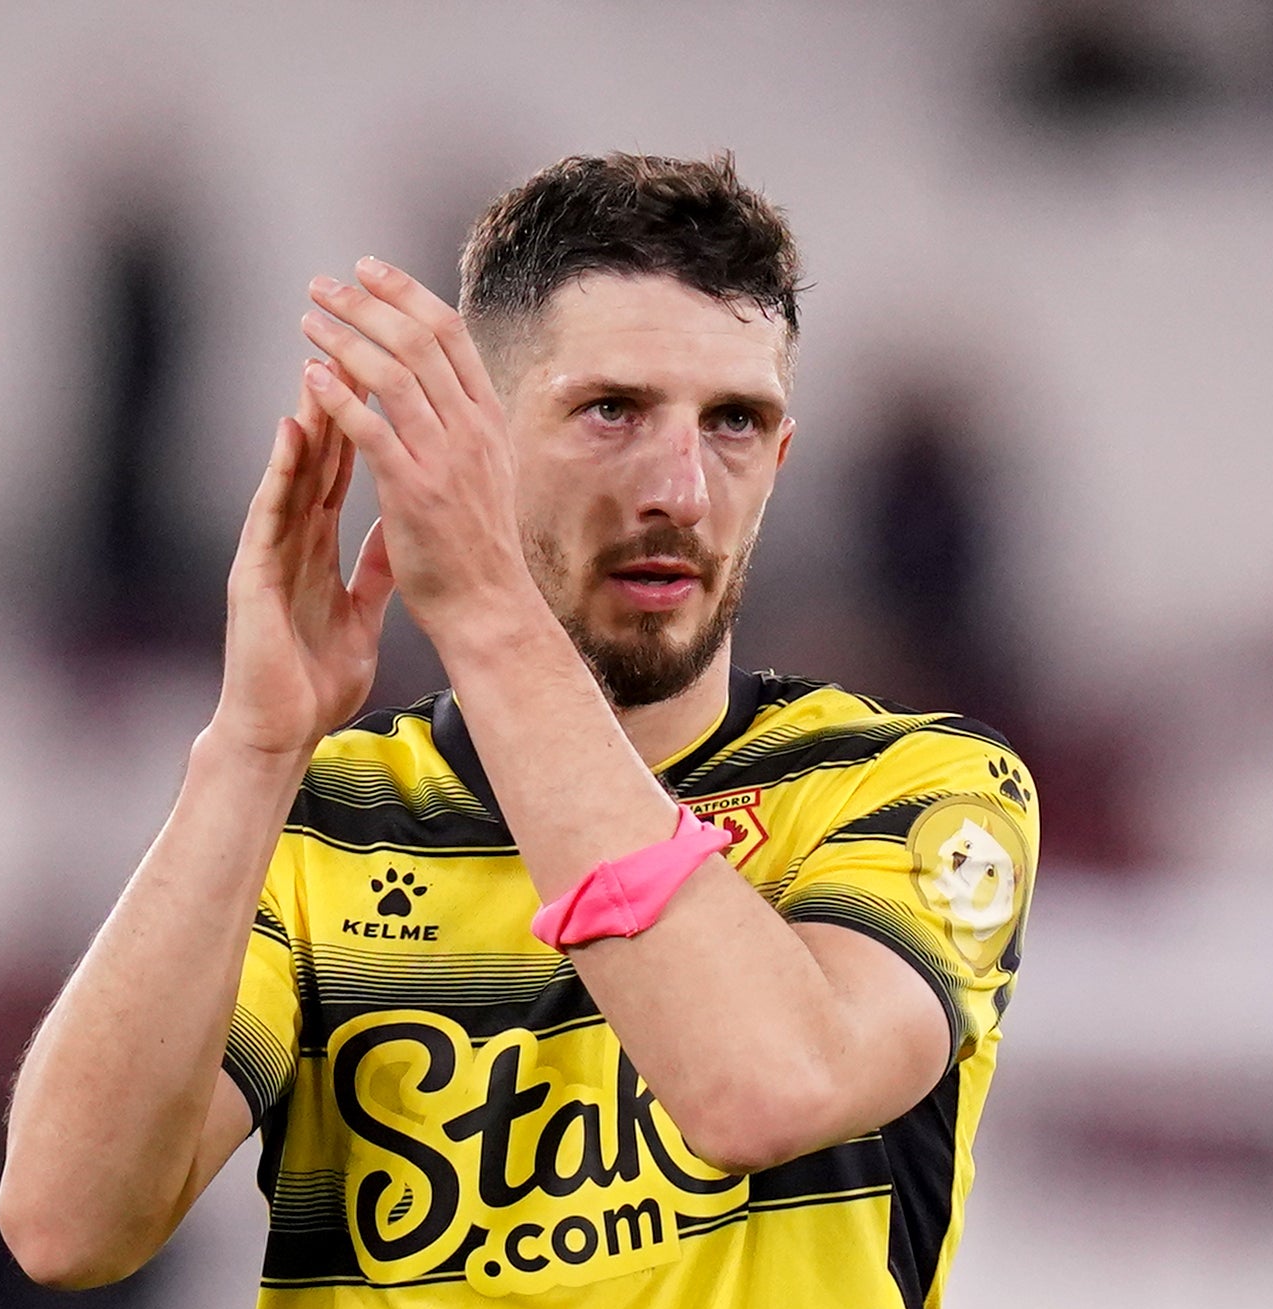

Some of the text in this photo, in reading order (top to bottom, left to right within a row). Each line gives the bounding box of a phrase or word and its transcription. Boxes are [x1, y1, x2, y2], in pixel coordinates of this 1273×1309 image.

[690, 795, 751, 814] ATFORD
[342, 919, 439, 941] KELME
[333, 1022, 745, 1262] Stak
[484, 1197, 663, 1278] .com
